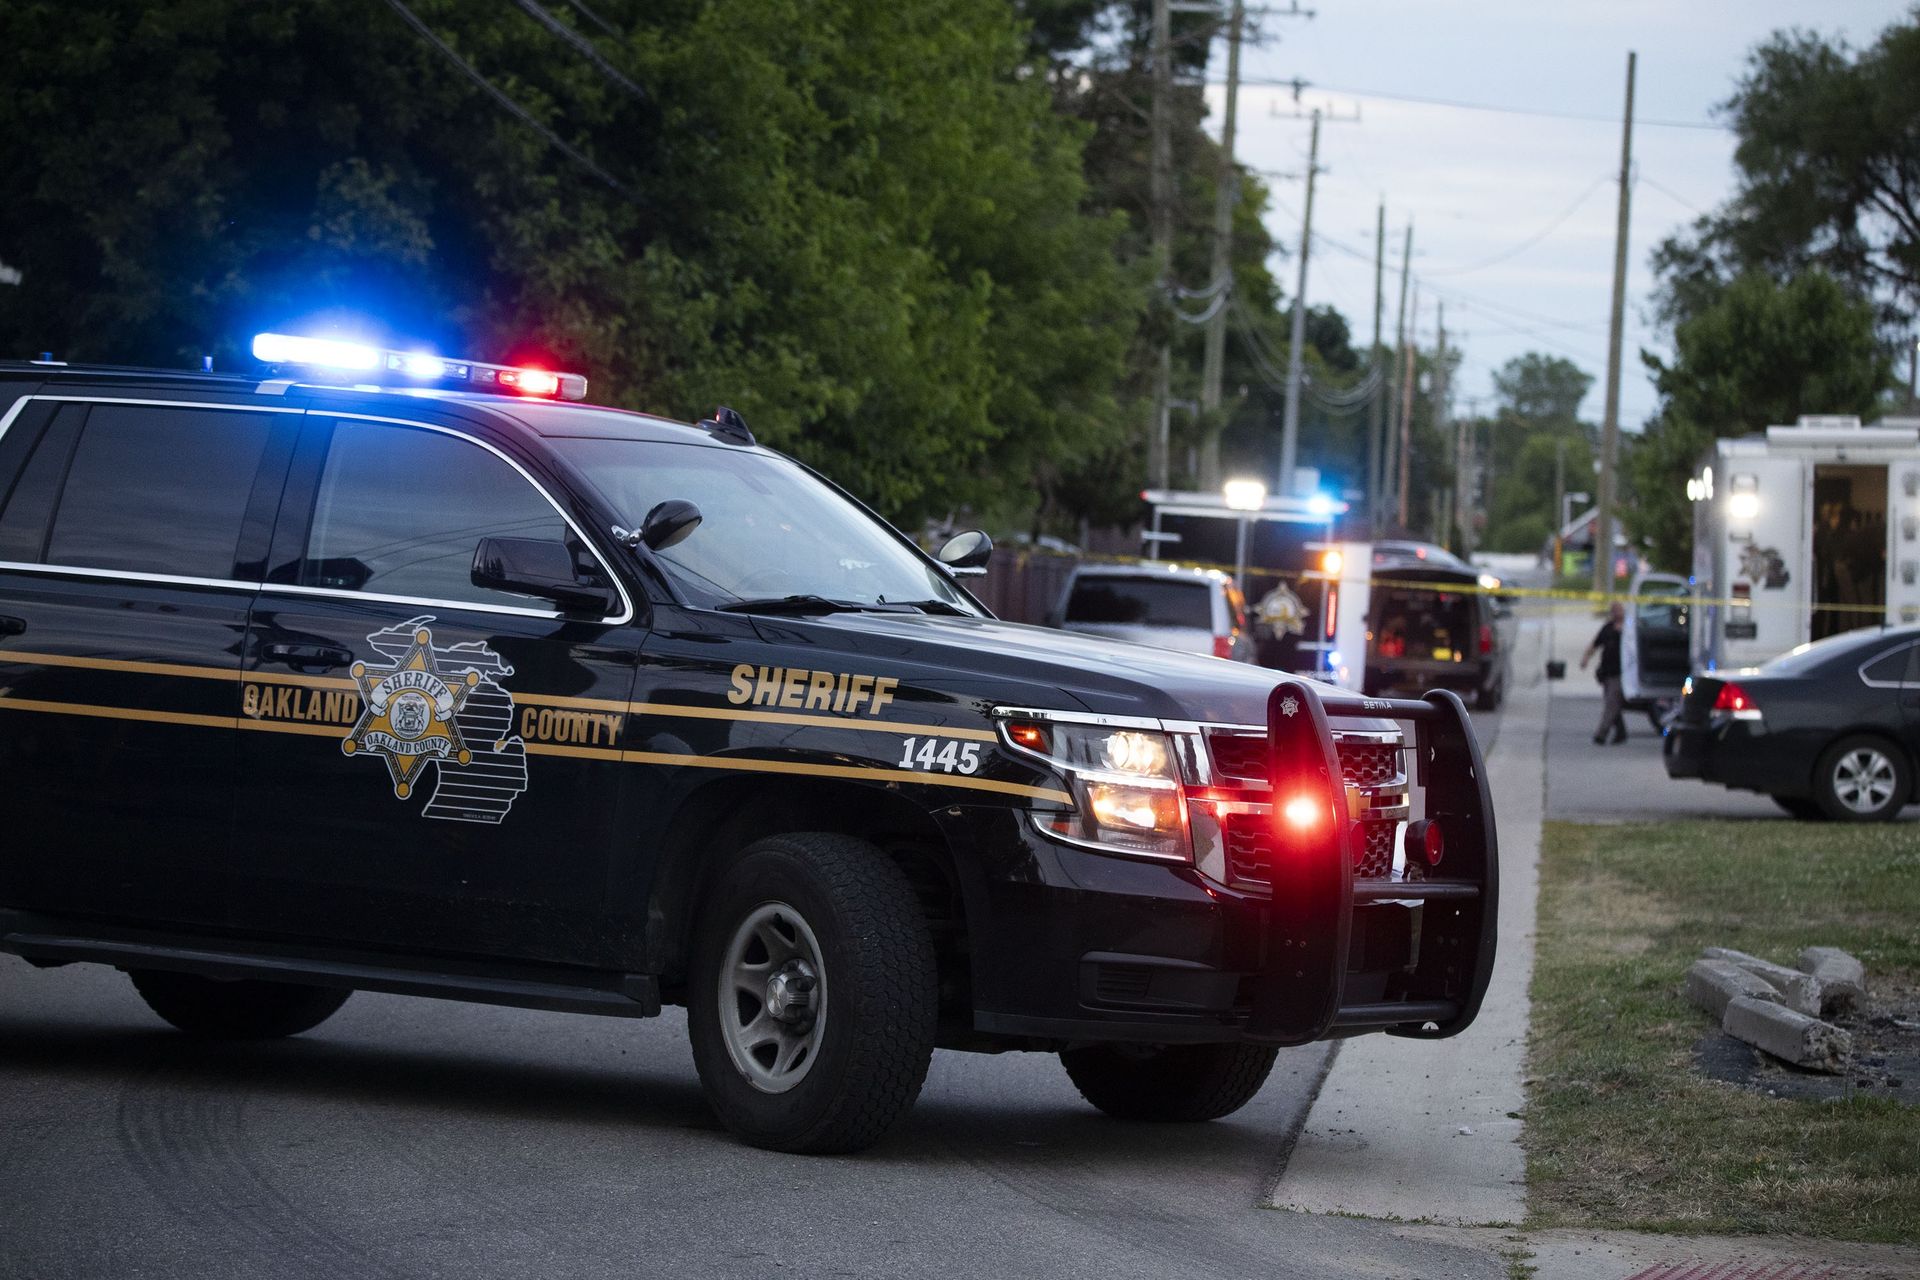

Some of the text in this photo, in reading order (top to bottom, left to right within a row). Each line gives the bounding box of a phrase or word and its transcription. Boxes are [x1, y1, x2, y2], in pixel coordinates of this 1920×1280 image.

[382, 672, 447, 698] SHERIFF
[727, 664, 899, 715] SHERIFF
[243, 684, 622, 746] OAKLAND COUNTY
[1363, 700, 1392, 709] SETINA
[367, 733, 411, 753] OAKLAND
[414, 738, 449, 753] COUNTY
[898, 737, 980, 774] 1445
